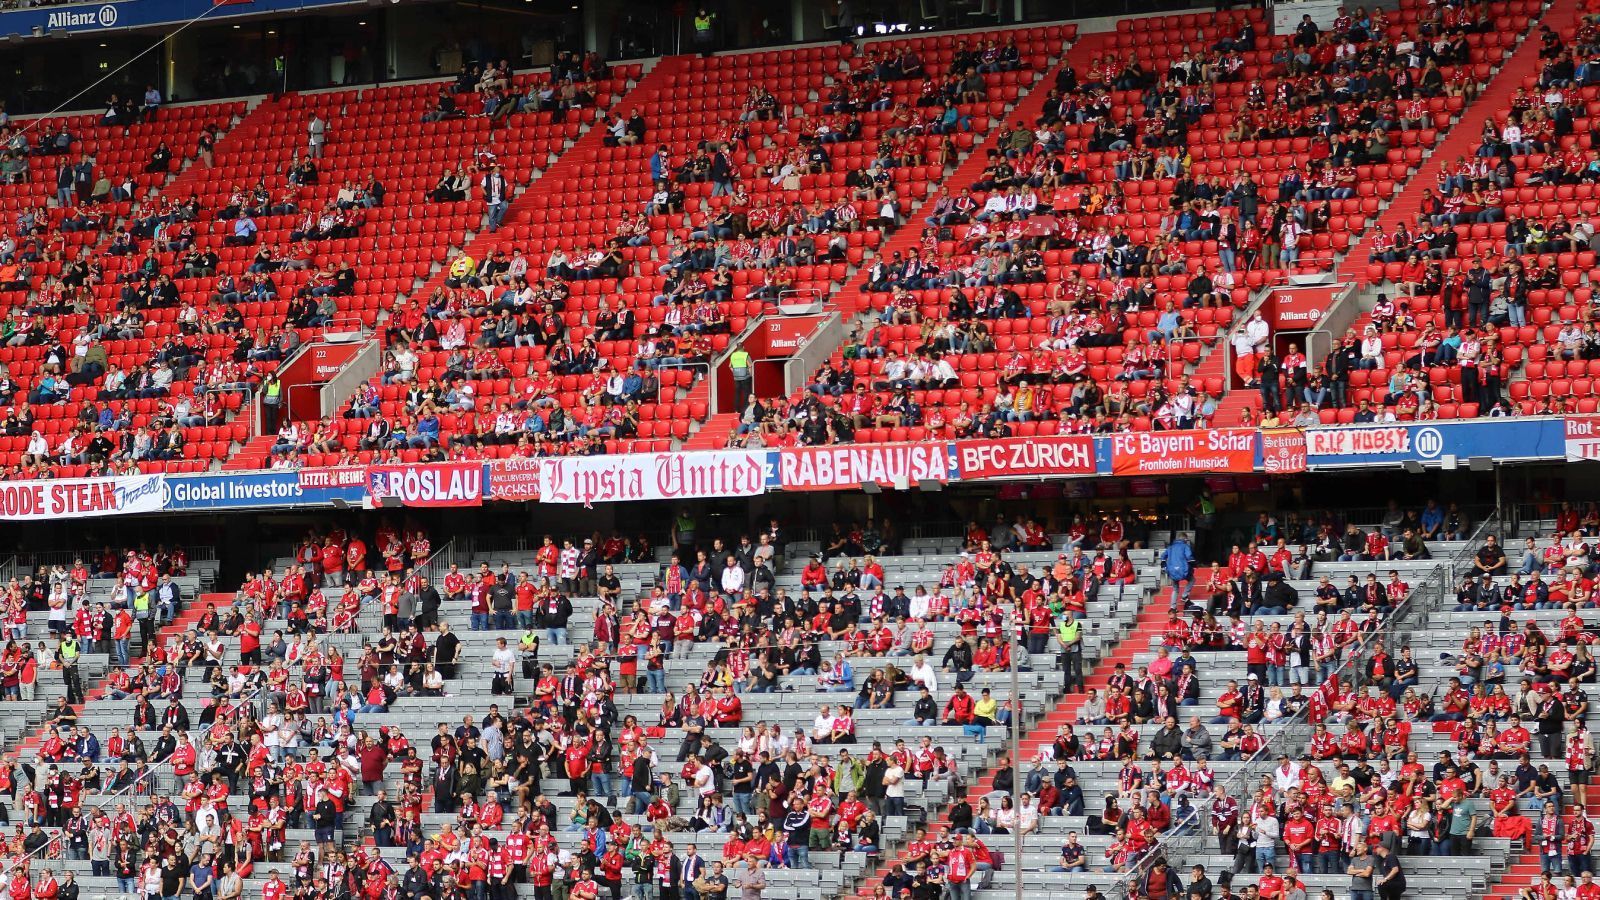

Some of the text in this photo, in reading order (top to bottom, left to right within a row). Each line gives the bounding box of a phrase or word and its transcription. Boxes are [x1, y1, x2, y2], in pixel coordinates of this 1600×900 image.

[47, 11, 96, 28] Allianz
[1279, 295, 1292, 303] 220
[1280, 312, 1308, 320] Allianz
[770, 324, 780, 332] 221
[771, 340, 796, 348] Allianz
[1567, 420, 1593, 435] Rot
[1115, 434, 1135, 456] FC
[1140, 433, 1194, 457] Bayern
[1208, 430, 1254, 450] Schar
[1264, 436, 1304, 448] Sektion
[963, 444, 1006, 472] BFC
[1009, 440, 1090, 468] ZÜRICH
[1139, 458, 1182, 470] Fronhofen
[1189, 457, 1229, 468] Hunsrück
[1265, 453, 1304, 472] Suff
[490, 459, 541, 472] FC BAYERN
[300, 470, 364, 486] LETZTE REIHE
[389, 468, 480, 501] RÖSLAU
[544, 454, 762, 508] Lipsia United
[174, 480, 303, 501] Global Investors
[490, 483, 541, 497] SACHSEN
